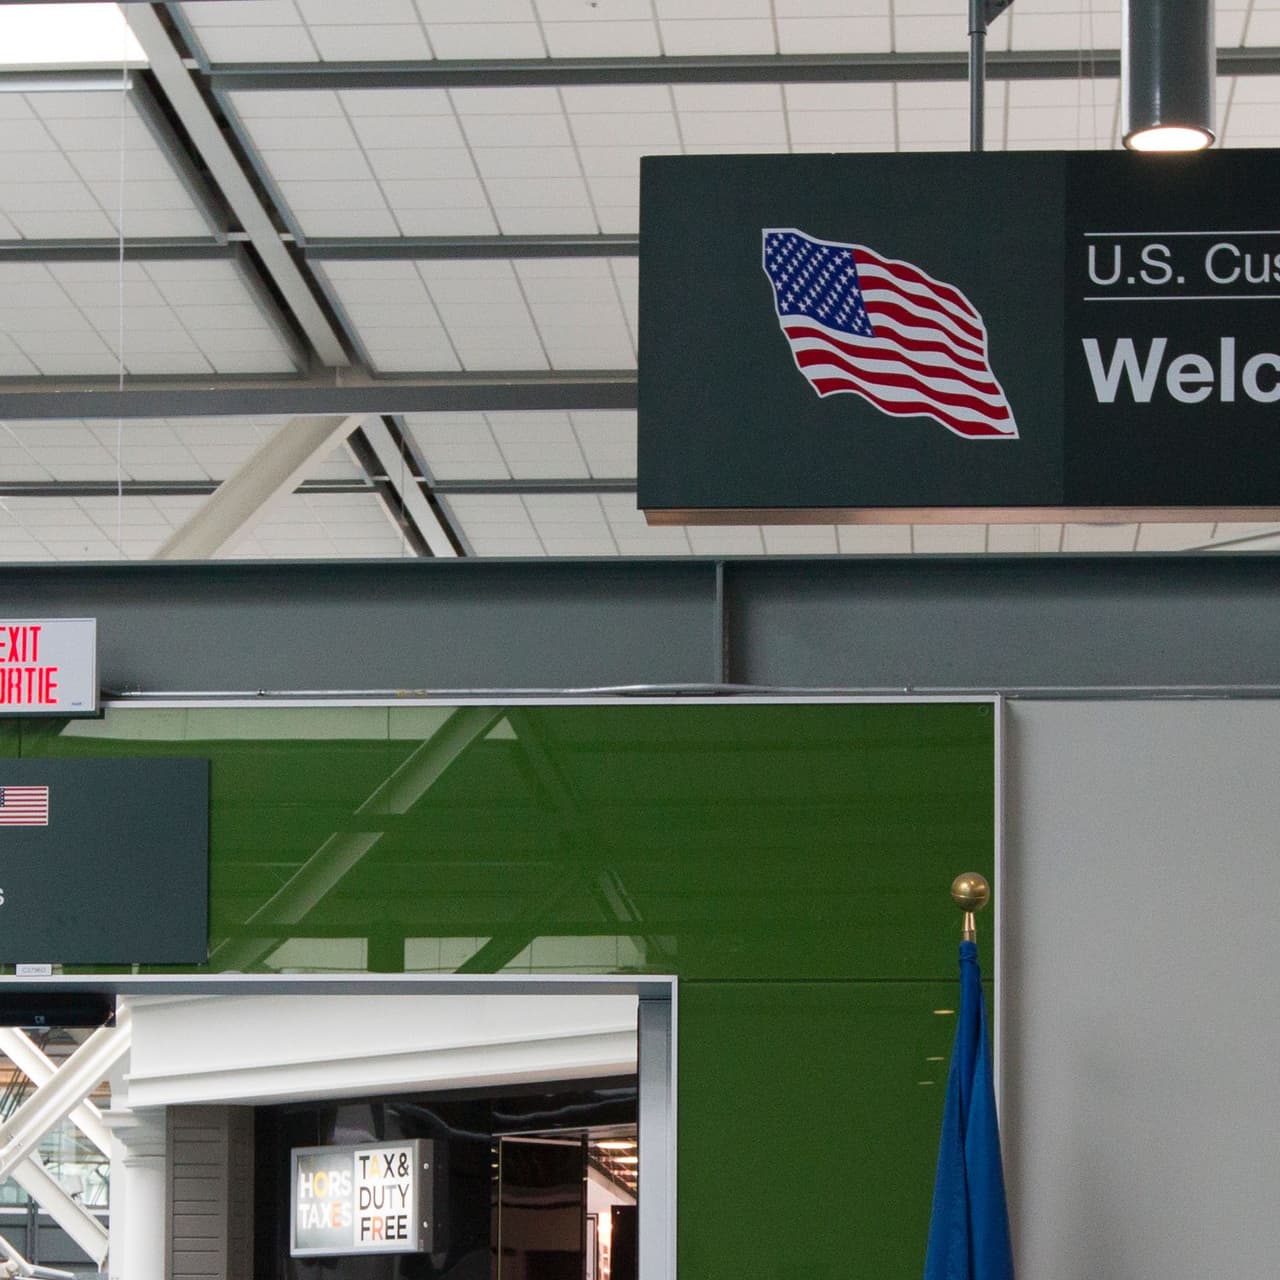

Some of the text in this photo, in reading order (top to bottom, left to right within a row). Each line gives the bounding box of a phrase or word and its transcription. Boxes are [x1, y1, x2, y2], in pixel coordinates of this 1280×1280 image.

[1088, 244, 1185, 286] U.S.
[300, 1170, 352, 1199] HORS
[359, 1184, 410, 1210] DUTY
[299, 1200, 352, 1229] TAXES
[361, 1215, 408, 1241] FREE
